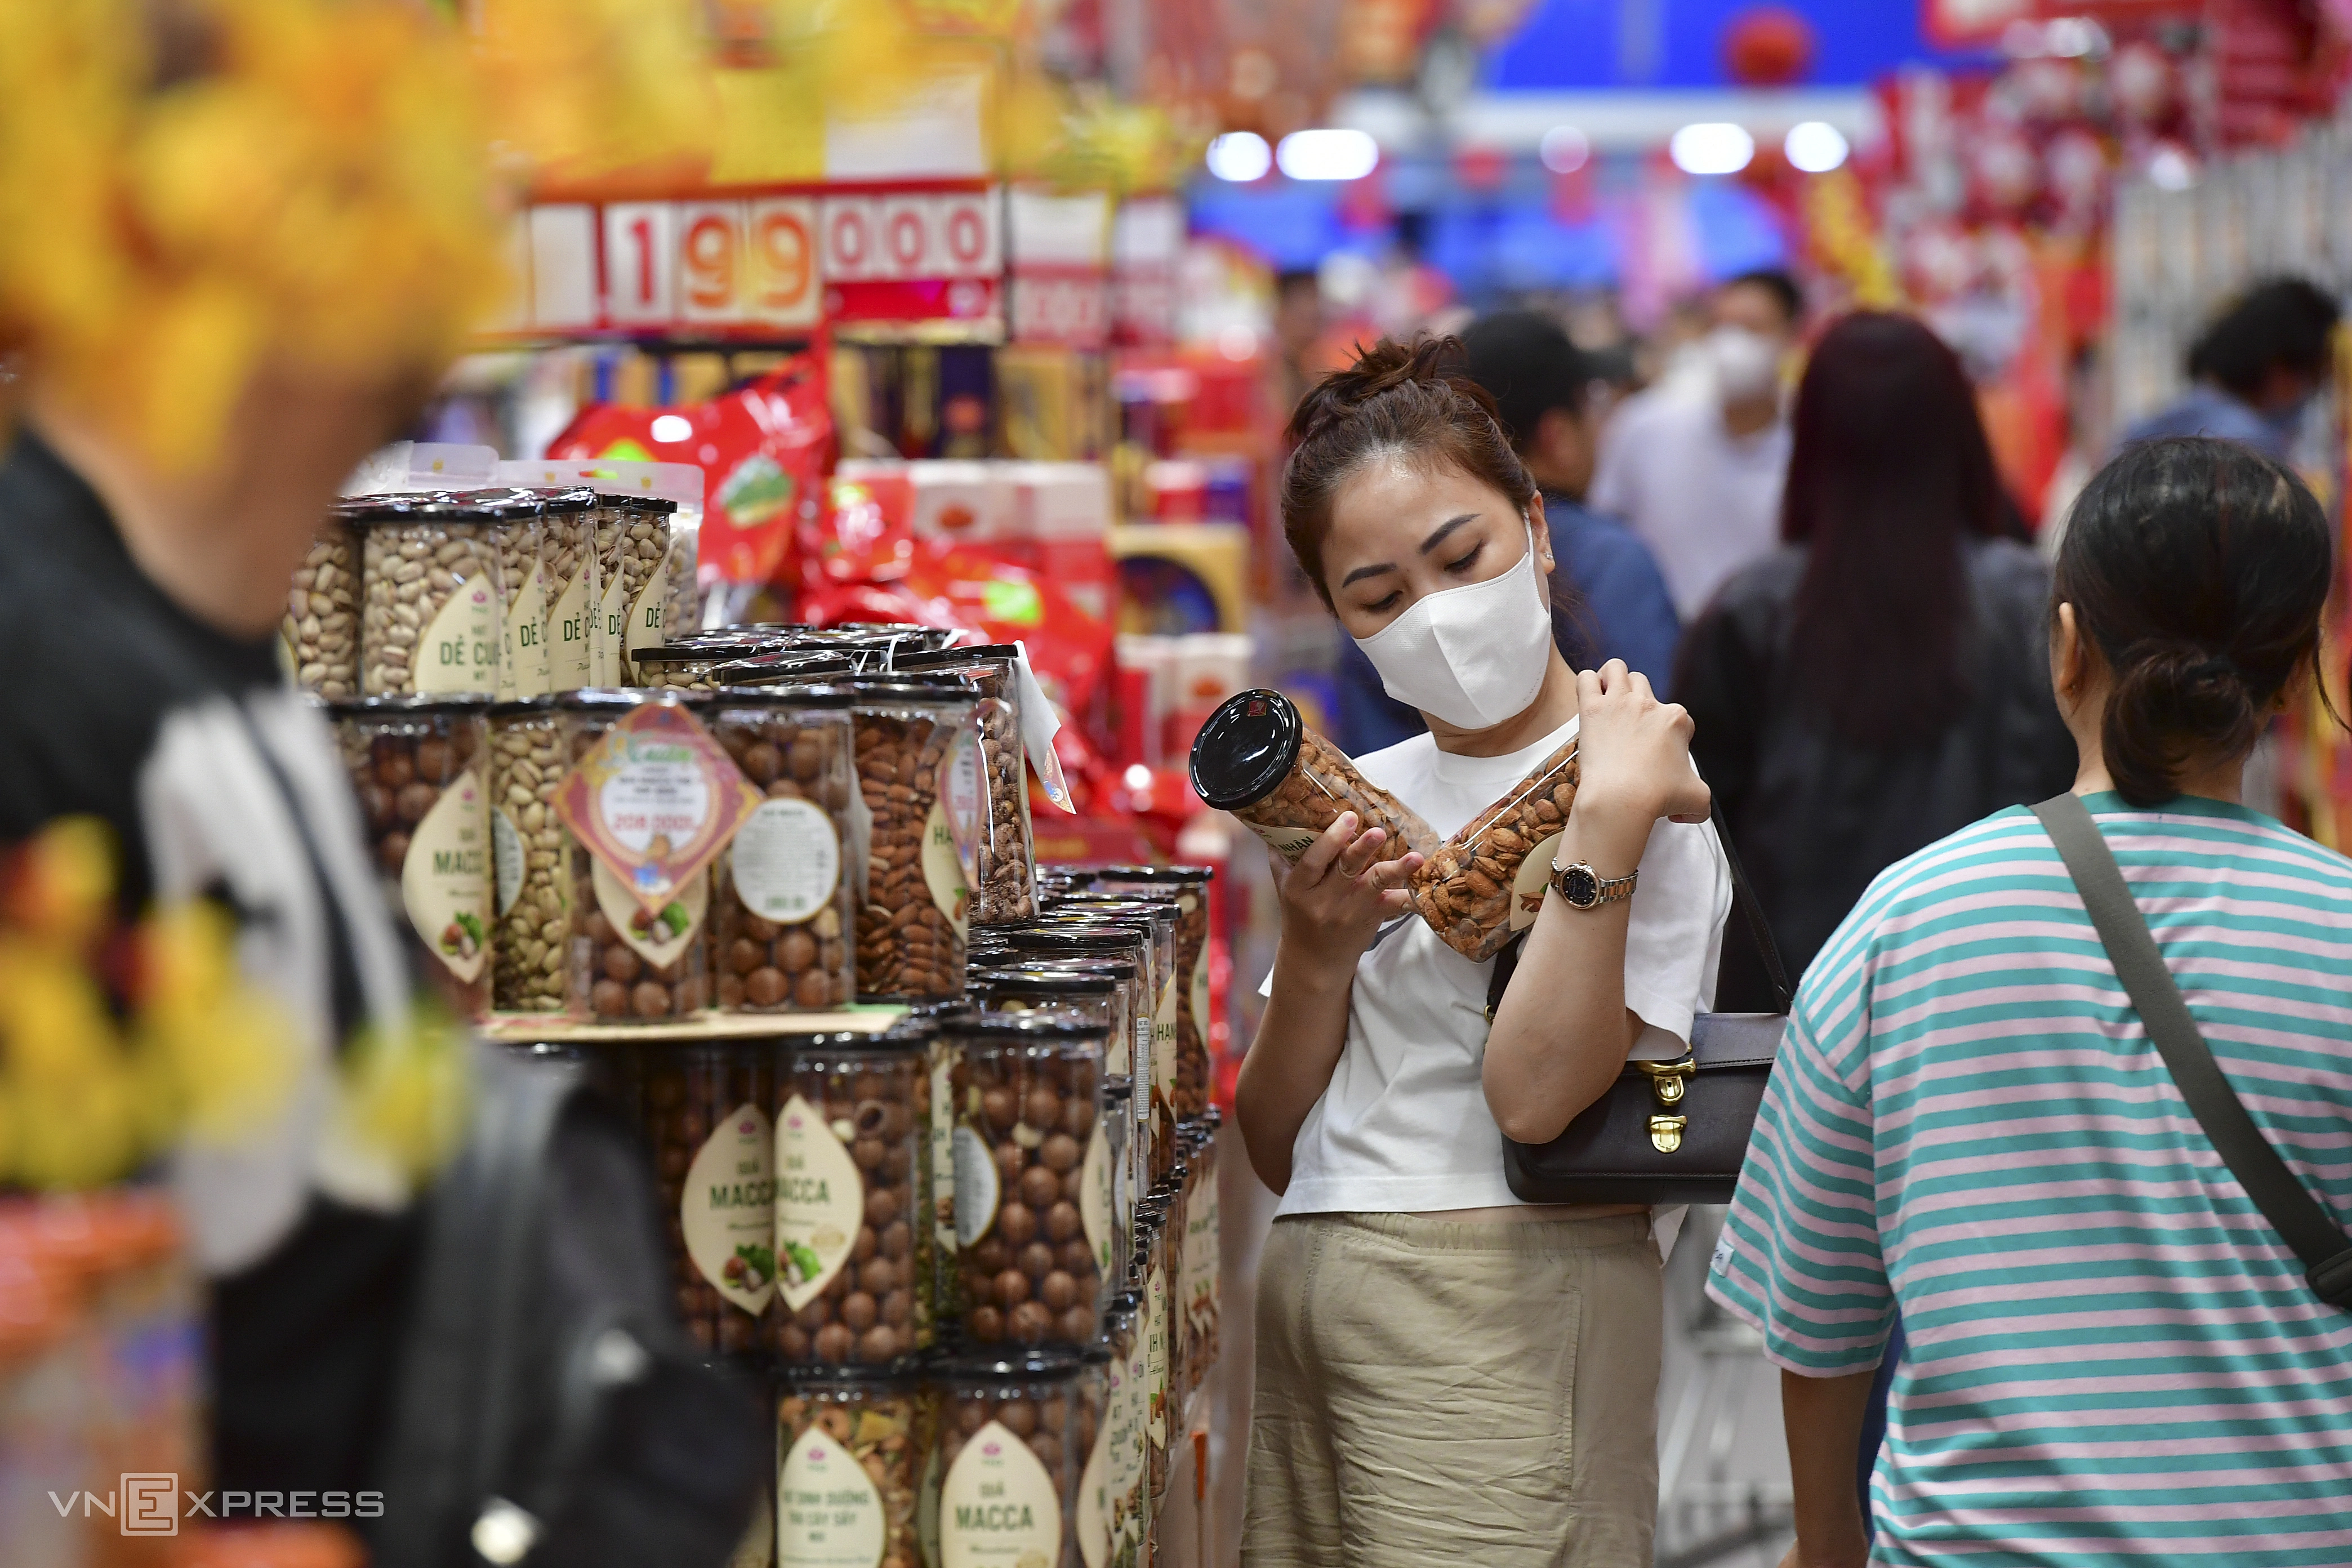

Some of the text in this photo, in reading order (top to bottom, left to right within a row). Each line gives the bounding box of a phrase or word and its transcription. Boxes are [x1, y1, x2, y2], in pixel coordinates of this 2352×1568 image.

[630, 208, 987, 308] 199 000
[520, 616, 538, 647] DẺ
[563, 612, 581, 641] DẺ
[440, 634, 465, 665] DẺ
[711, 1182, 774, 1209] MACC
[956, 1504, 1034, 1531] MACCA
